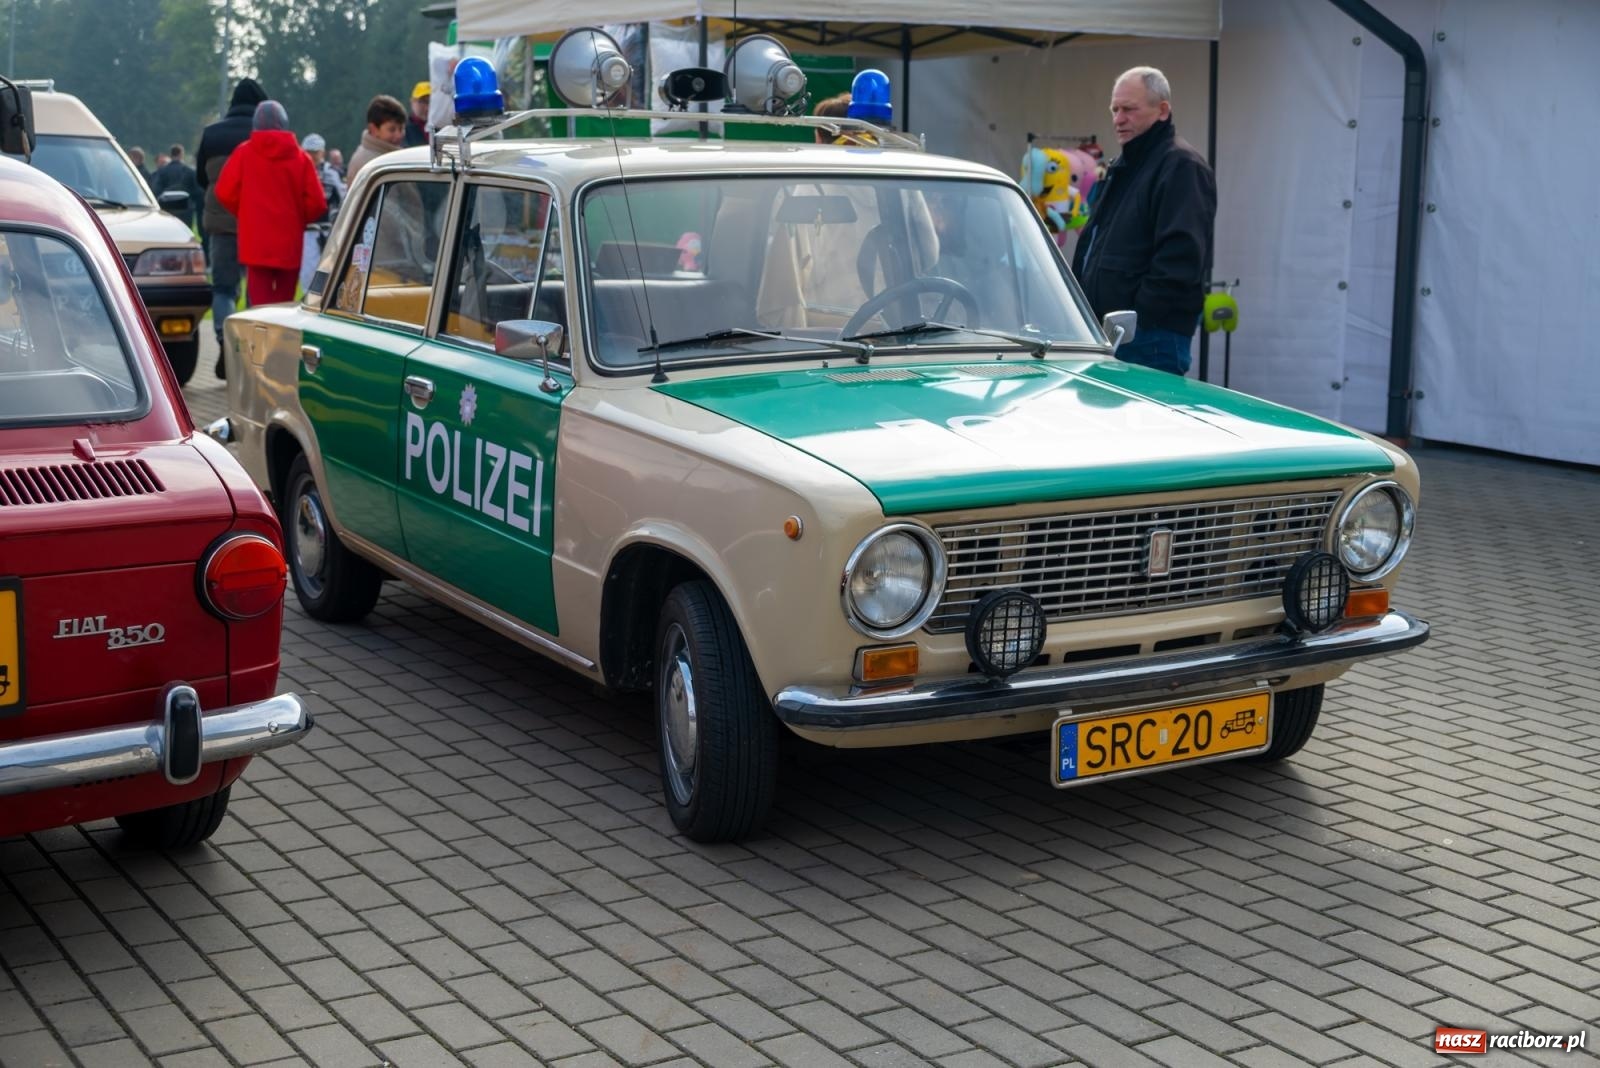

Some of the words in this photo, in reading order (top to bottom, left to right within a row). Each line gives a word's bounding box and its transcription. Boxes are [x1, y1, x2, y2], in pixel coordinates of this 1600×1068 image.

[405, 411, 544, 537] POLIZEI
[57, 615, 107, 636] FIAT
[108, 622, 166, 649] 850
[1085, 718, 1158, 769] SRC
[1171, 710, 1212, 756] 20
[1062, 758, 1075, 770] PL
